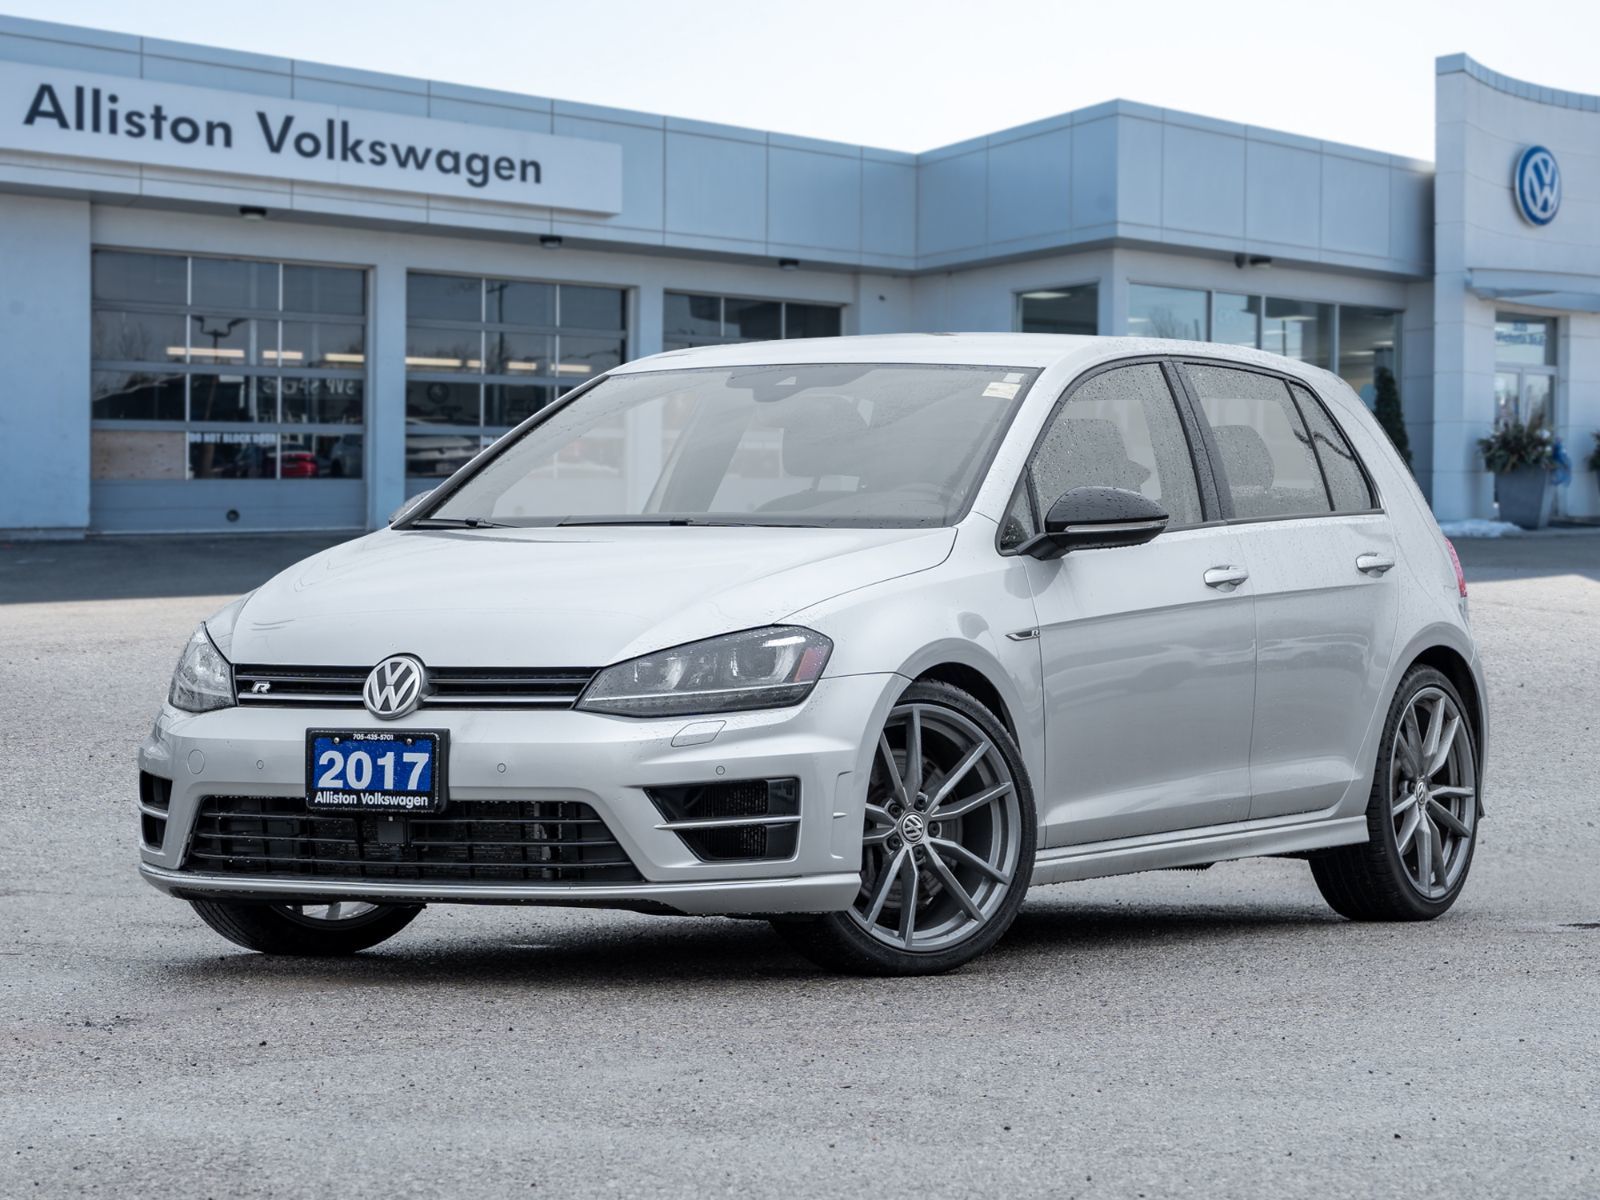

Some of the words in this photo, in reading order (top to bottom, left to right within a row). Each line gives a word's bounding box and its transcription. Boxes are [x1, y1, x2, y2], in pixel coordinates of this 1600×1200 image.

[23, 83, 234, 149] Alliston
[256, 110, 543, 188] Volkswagen
[251, 681, 271, 694] R
[352, 733, 394, 742] 705-435-5701
[317, 750, 430, 791] 2017
[314, 791, 357, 805] Alliston
[360, 792, 428, 809] Volkswagen
